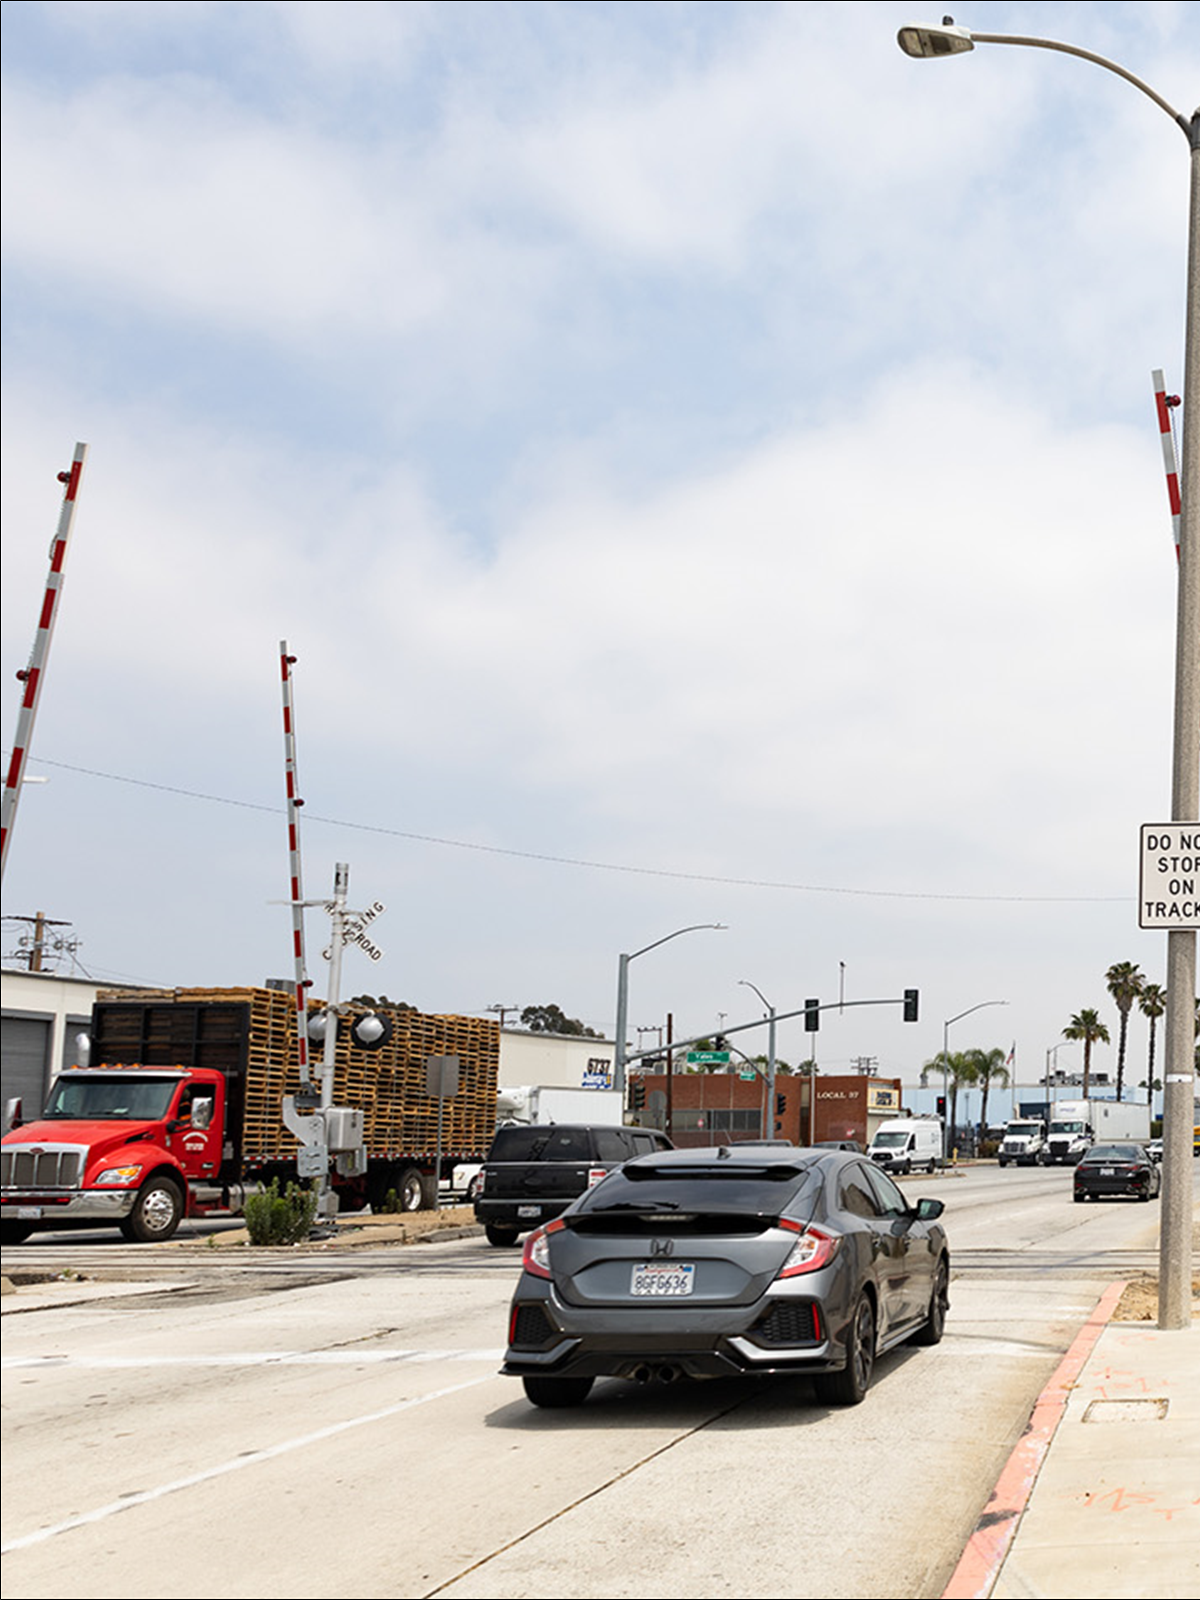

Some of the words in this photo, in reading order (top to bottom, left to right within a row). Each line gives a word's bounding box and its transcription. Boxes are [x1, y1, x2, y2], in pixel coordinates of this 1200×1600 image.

[1147, 834, 1171, 851] DO
[1169, 879, 1194, 895] ON
[816, 1091, 847, 1099] LOCAL
